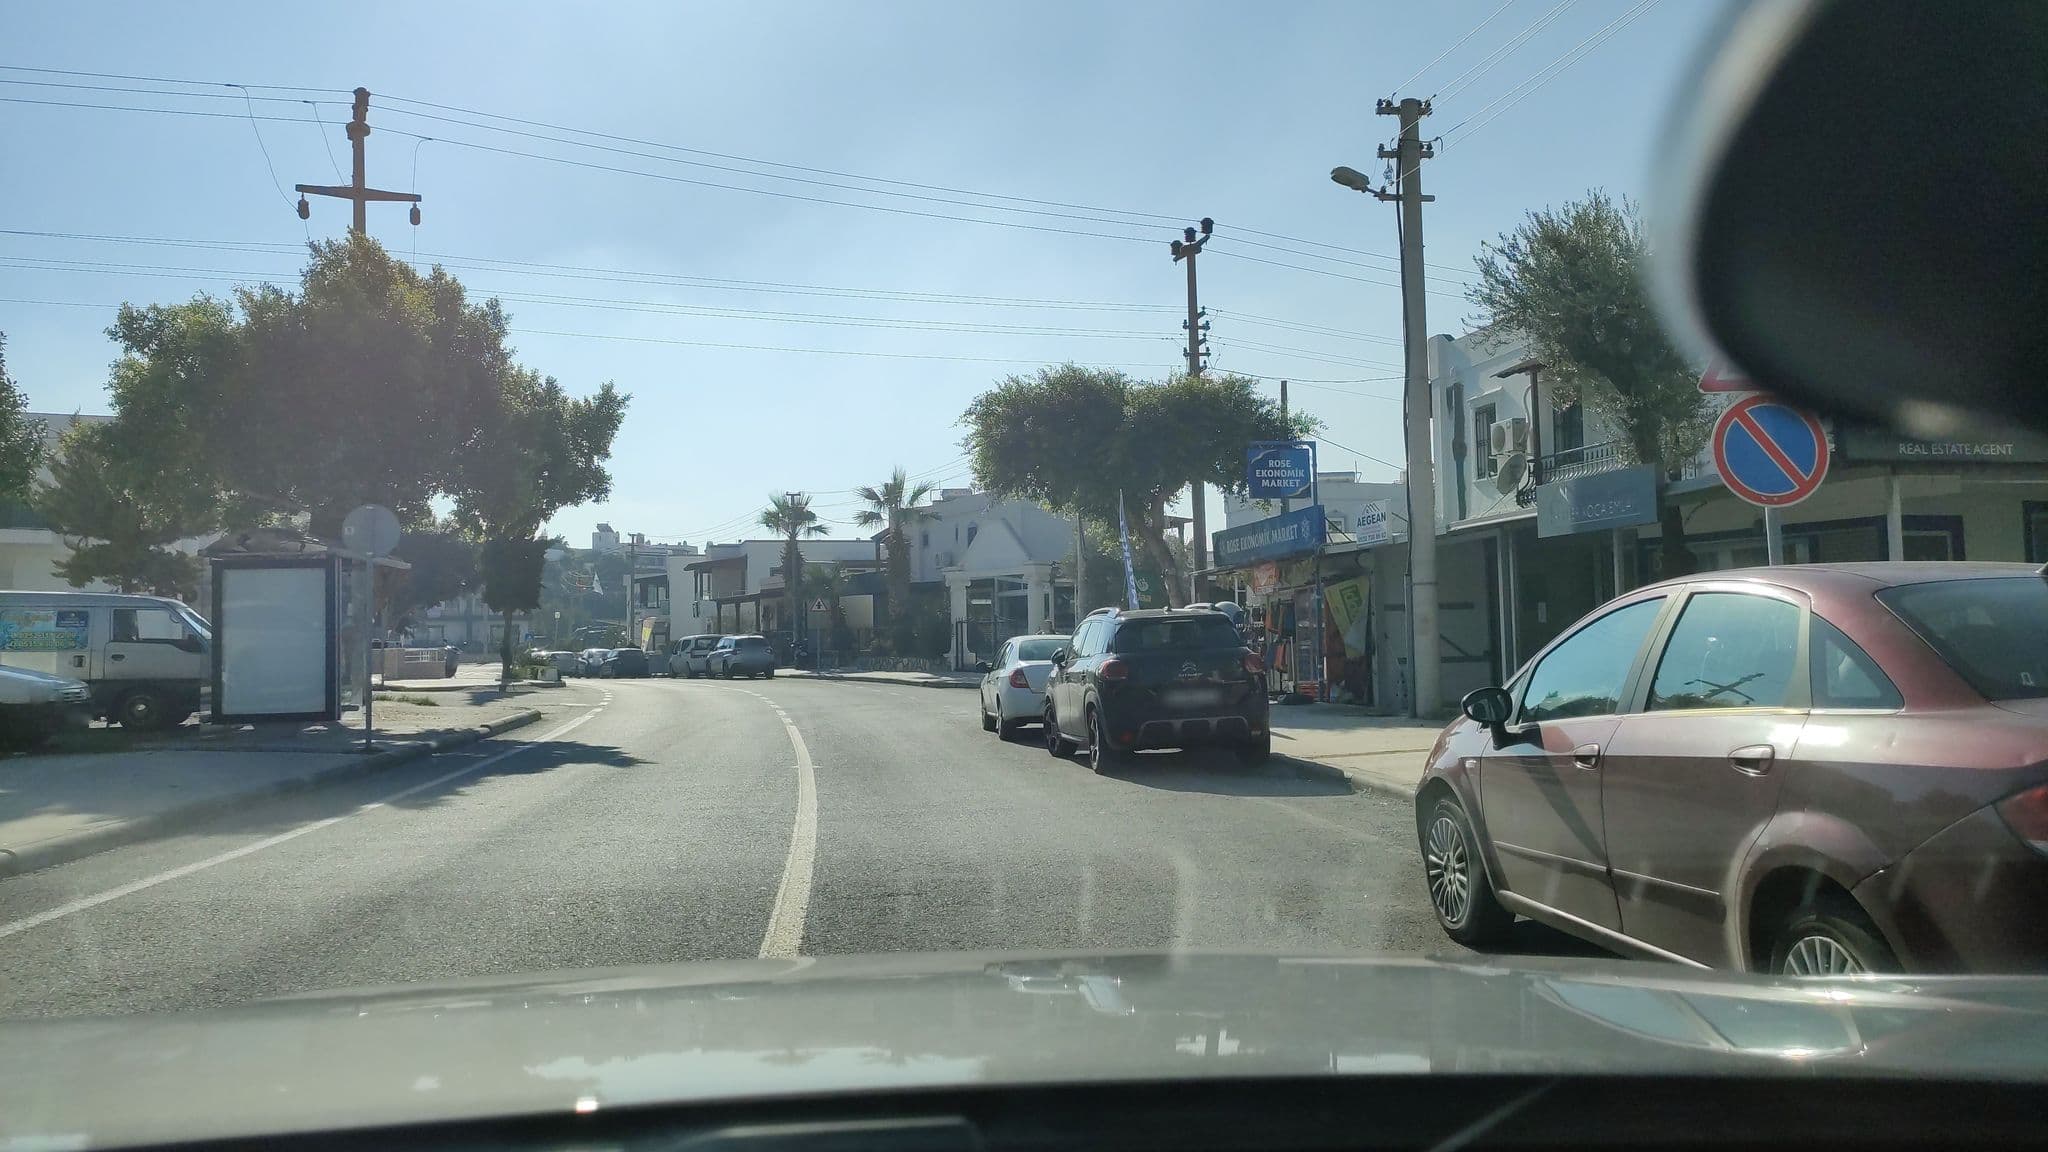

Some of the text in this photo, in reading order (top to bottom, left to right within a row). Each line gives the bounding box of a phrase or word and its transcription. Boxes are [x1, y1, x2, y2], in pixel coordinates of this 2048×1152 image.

[1898, 443, 2013, 455] REAL ESTATE AGENT
[1268, 459, 1292, 468] ROSE
[1261, 479, 1301, 488] MARKET
[1357, 512, 1387, 527] AEGEAN
[1226, 538, 1240, 554] ROSE
[1271, 524, 1298, 544] MARKET
